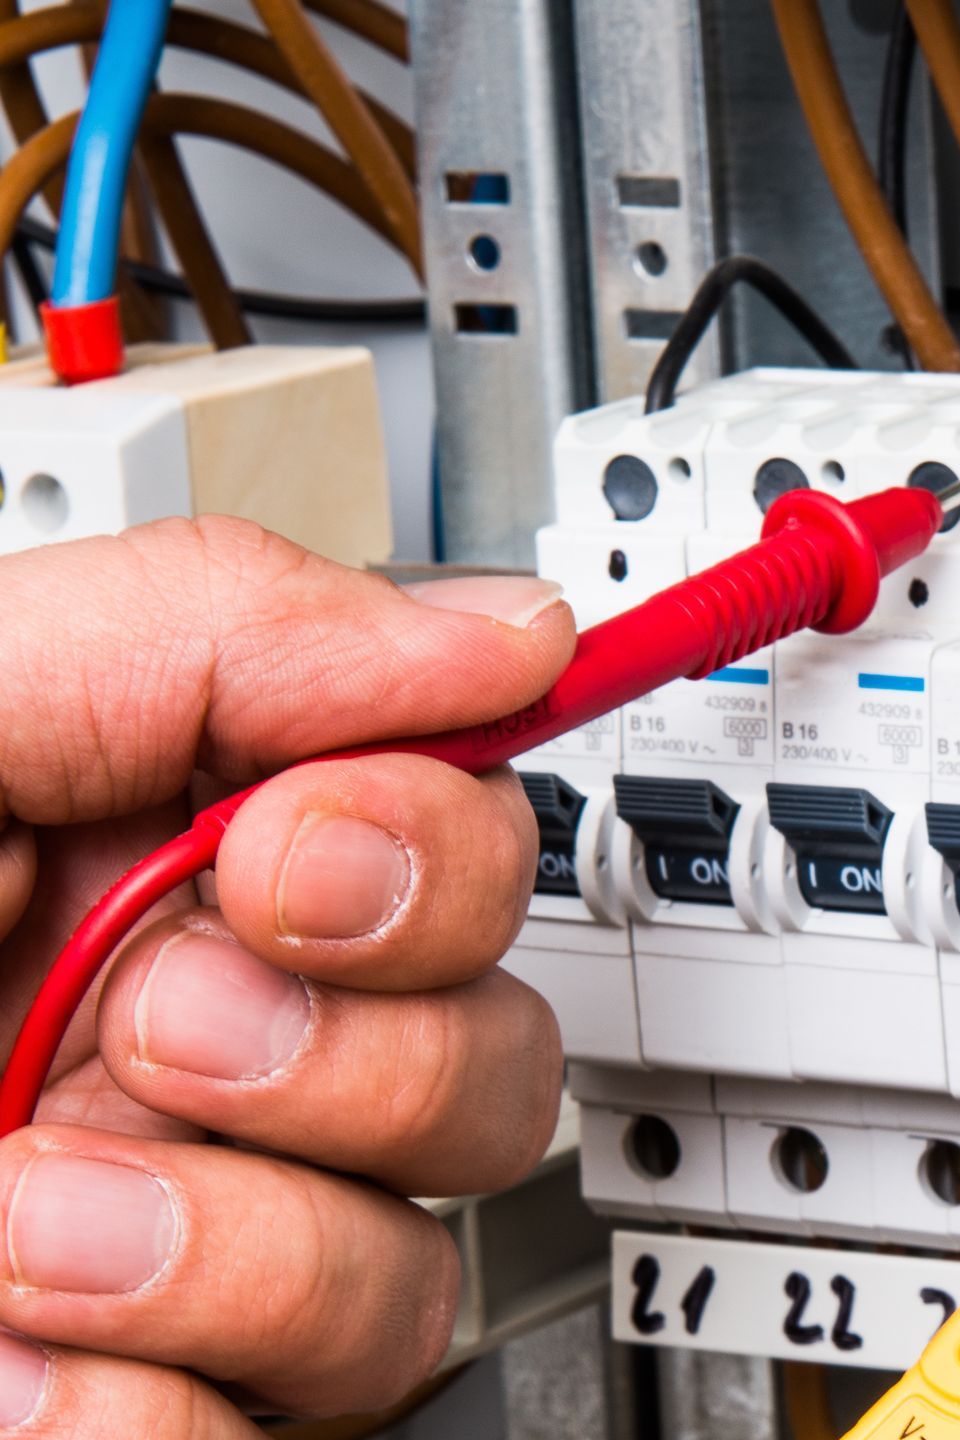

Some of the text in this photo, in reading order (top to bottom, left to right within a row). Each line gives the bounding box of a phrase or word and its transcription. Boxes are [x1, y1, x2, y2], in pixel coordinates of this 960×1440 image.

[782, 722, 818, 740] B 16
[938, 738, 950, 755] B
[691, 858, 729, 884] ON
[840, 866, 883, 894] ON
[632, 1253, 716, 1334] 21
[783, 1271, 864, 1351] 22
